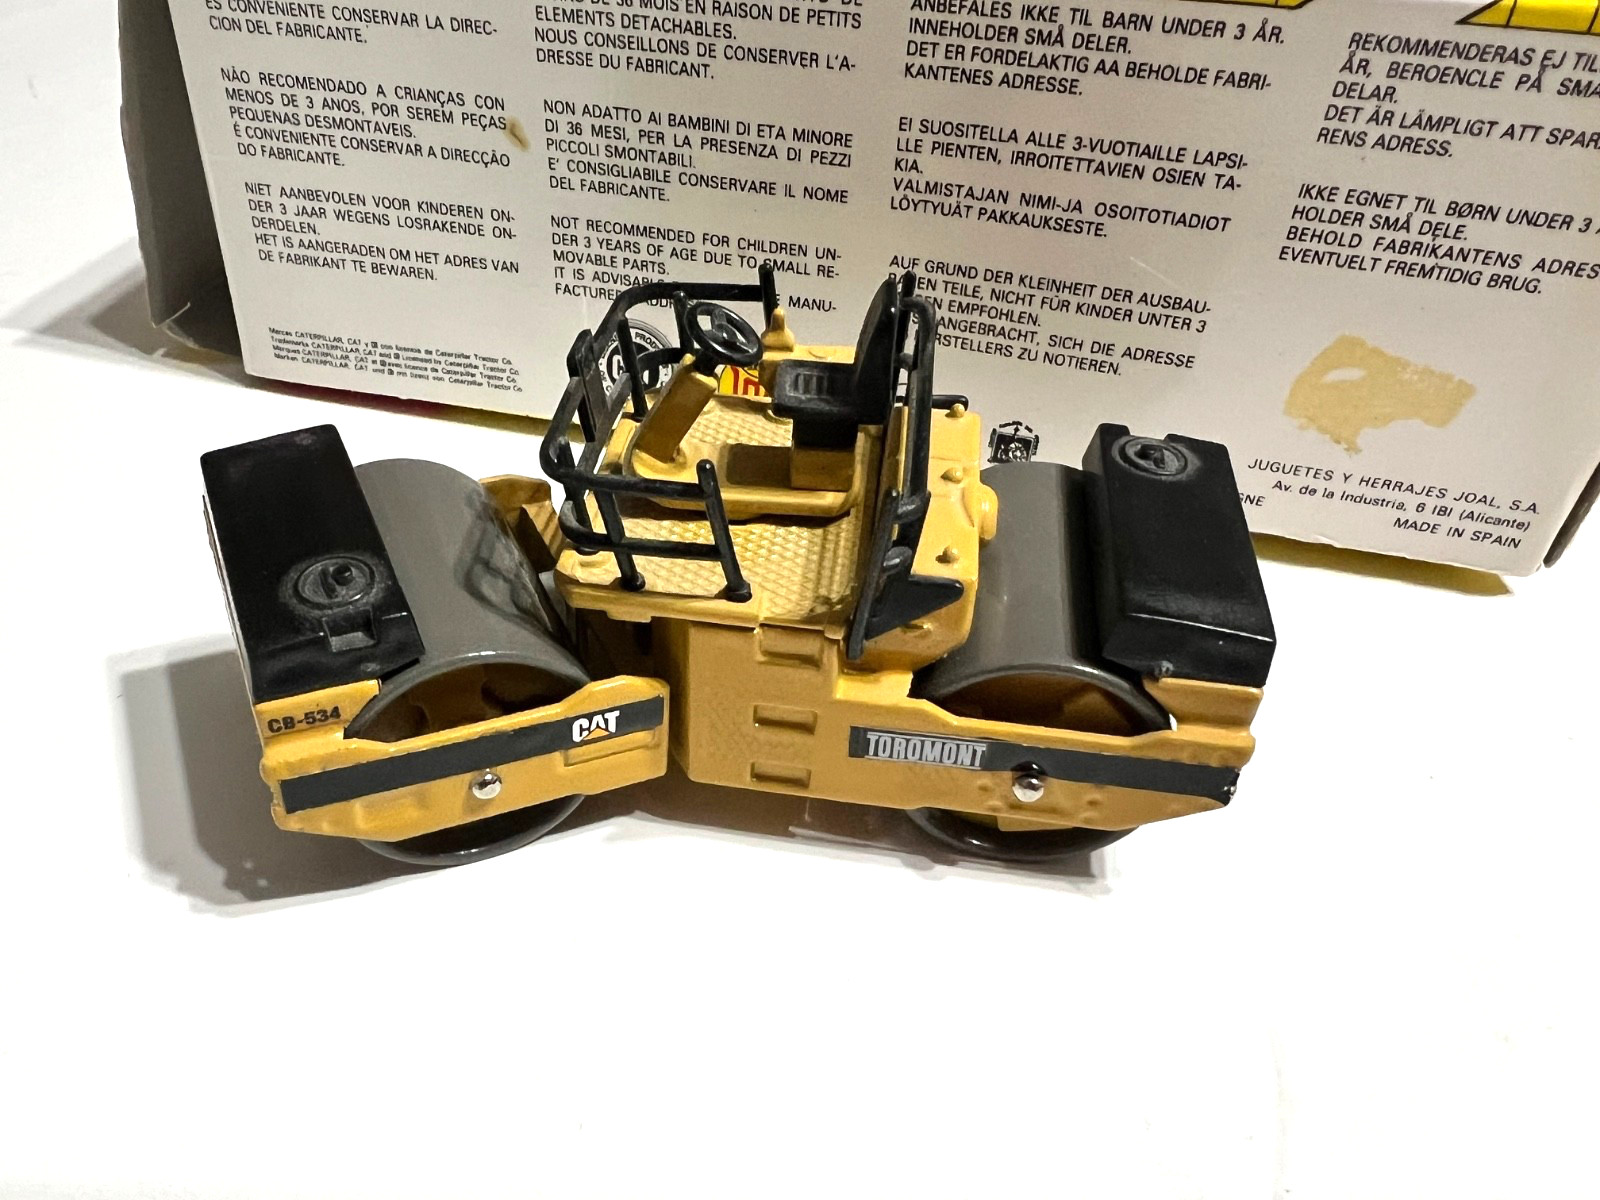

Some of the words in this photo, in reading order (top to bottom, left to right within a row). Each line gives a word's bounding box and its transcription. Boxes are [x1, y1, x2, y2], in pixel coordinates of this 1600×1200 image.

[208, 14, 242, 32] CION
[244, 18, 273, 36] DEL
[275, 21, 367, 44] FABRICANTE.
[535, 4, 615, 28] ELEMENTS
[620, 13, 737, 40] DETACHABLES.
[908, 18, 1019, 44] INNEHOLDER
[1024, 27, 1065, 48] SMÅ
[1071, 32, 1132, 55] DELER.
[535, 47, 594, 68] DRESSE
[599, 53, 621, 70] DU
[626, 56, 714, 80] FABRICANT.
[906, 40, 939, 59] DET
[944, 44, 966, 62] ER
[970, 46, 1090, 74] FORDELAKTIG
[1092, 59, 1120, 77] AA
[1124, 61, 1210, 85] BEHOLDE
[1212, 70, 1271, 91] FABRI-
[1347, 32, 1536, 67] REKOMMENDERAS
[1539, 51, 1567, 70] EJ
[1572, 54, 1598, 73] TIL
[258, 71, 367, 96] RECOMENDADO
[376, 84, 387, 98] A
[394, 85, 466, 108] CRIANÇAS
[474, 94, 505, 112] CON
[904, 62, 994, 86] KANTENES
[997, 72, 1082, 96] ADRESSE.
[1331, 80, 1398, 104] DELAR.
[224, 86, 275, 106] MENOS
[280, 92, 299, 108] DE
[305, 95, 314, 110] 3
[321, 97, 365, 116] ANOS,
[370, 102, 400, 118] POR
[406, 106, 454, 125] SEREM
[461, 111, 507, 131] PEÇAS
[228, 105, 301, 127] PEQUENAS
[304, 113, 416, 139] DESMONTAVEIS.
[543, 98, 576, 116] NON
[581, 103, 642, 124] ADATTO
[647, 110, 662, 126] AI
[667, 112, 730, 134] BAMBINI
[735, 120, 751, 137] DI
[756, 123, 786, 141] ETA
[792, 127, 853, 149] MINORE
[1323, 104, 1363, 124] DET
[1364, 104, 1395, 127] ÄR
[1398, 109, 1499, 138] LÄMPLIGT
[1498, 124, 1543, 143] ATT
[236, 141, 257, 157] DO
[260, 144, 345, 167] FABRICANTE.
[546, 137, 600, 157] PICCOLI
[604, 143, 696, 169] SMONTABILI.
[898, 116, 913, 132] EI
[918, 118, 1019, 144] SUOSITELLA
[1024, 130, 1067, 150] ALLE
[1072, 135, 1188, 164] 3-VUOTIAILLE
[1192, 148, 1248, 170] LAPSI-
[1316, 126, 1368, 148] RENS
[1370, 133, 1453, 158] ADRESS.
[547, 156, 559, 171] E'
[566, 158, 671, 184] CONSIGLIABILE
[678, 171, 777, 196] CONSERVARE
[784, 183, 796, 198] IL
[803, 185, 849, 204] NOME
[894, 158, 923, 174] KIA.
[244, 181, 271, 197] NIET
[279, 185, 367, 207] AANBEVOLEN
[371, 195, 411, 212] VOOR
[416, 200, 484, 220] KINDEREN
[490, 208, 515, 223] ON-
[549, 175, 575, 191] DEL
[579, 178, 670, 202] FABRICANTE.
[893, 178, 1010, 205] VALMISTAJAN
[1019, 193, 1083, 214] NIMI-JA
[1094, 202, 1231, 232] OSOITOTIADIOT
[251, 215, 320, 236] DERDELEN.
[977, 207, 1107, 238] PAKKAUKSESTE.
[1291, 204, 1365, 228] HOLDER
[1368, 213, 1413, 234] SMÅ
[1417, 220, 1468, 241] DELE.
[1297, 183, 1340, 203] IKKE
[1343, 188, 1408, 210] EGNET
[1408, 196, 1437, 215] TIL
[1444, 200, 1502, 222] BØRN
[1505, 208, 1575, 231] UNDER
[1577, 216, 1593, 234] 3
[550, 214, 579, 230] NOT
[585, 218, 695, 244] RECOMMENDED
[702, 232, 730, 248] FOR
[737, 236, 808, 258] CHILDREN
[815, 246, 842, 261] UN-
[1285, 225, 1363, 249] BEHOLD
[1372, 236, 1523, 270] FABRIKANTENS
[258, 248, 274, 262] DE
[277, 251, 347, 270] FABRIKANT
[350, 259, 367, 273] TE
[370, 261, 438, 281] BEWAREN.
[552, 250, 618, 269] MOVABLE
[622, 257, 670, 275] PARTS.
[1278, 245, 1382, 272] EVENTUELT
[1383, 259, 1484, 286] FREMTIDIG
[1485, 272, 1542, 294] BRUG.
[888, 254, 920, 273] AUF
[924, 259, 979, 280] GRUND
[982, 268, 1014, 285] DER
[1017, 273, 1098, 298] KLEINHEIT
[1100, 286, 1134, 304] DER
[1136, 291, 1211, 314] AUSBAU-
[788, 296, 836, 312] MANU-
[947, 299, 1041, 327] EMPFOHLEN.
[1247, 458, 1334, 482] JUGUETES
[1342, 472, 1353, 484] Y
[1358, 475, 1448, 499] HERRAJES
[1271, 480, 1292, 492] Av.
[1298, 484, 1318, 497] de
[1321, 487, 1335, 500] la
[1415, 502, 1427, 513] 6
[1431, 504, 1454, 518] IBI
[1458, 509, 1531, 531] (Alicante)
[1392, 517, 1442, 535] MADE
[1446, 526, 1466, 538] IN
[1469, 530, 1522, 549] SPAIN
[267, 706, 342, 734] CB-534
[572, 710, 620, 742] CAT
[866, 734, 986, 767] TOROMONT
